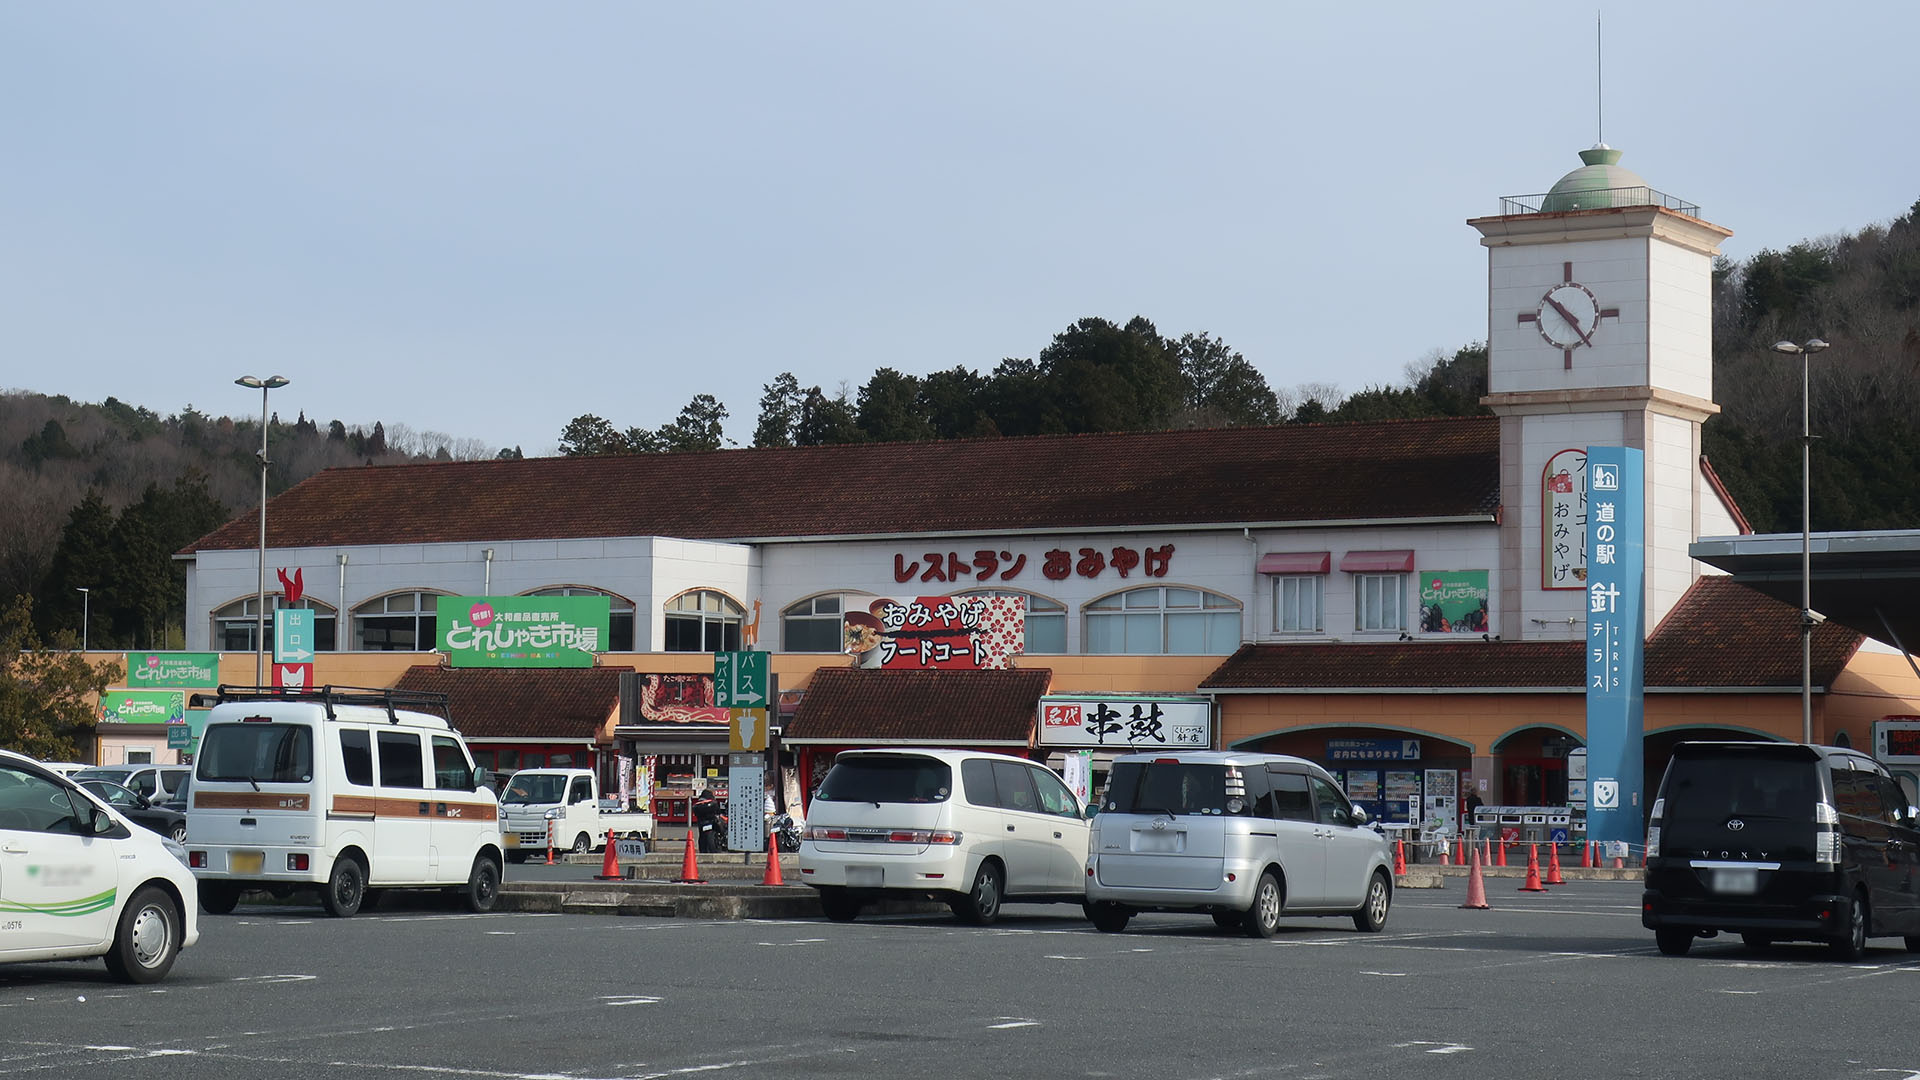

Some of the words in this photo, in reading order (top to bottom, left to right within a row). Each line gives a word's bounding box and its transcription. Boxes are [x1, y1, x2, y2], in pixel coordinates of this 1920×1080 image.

[1554, 502, 1570, 582] おみやげ
[1596, 502, 1615, 564] 道の駅
[894, 550, 1027, 583] レストラン
[1042, 544, 1176, 580] おみやげ
[1591, 582, 1620, 613] 針
[290, 613, 301, 645] 出口
[882, 601, 986, 627] おみやげ
[446, 620, 598, 651] とれしゃき市場
[880, 639, 987, 666] フードコート
[1593, 623, 1603, 688] テラス
[135, 665, 211, 681] とれしゃき市場
[741, 653, 755, 690] バス
[1047, 707, 1080, 726] 名代
[1086, 703, 1166, 744] 串鼓
[1702, 850, 1768, 859] VOXY
